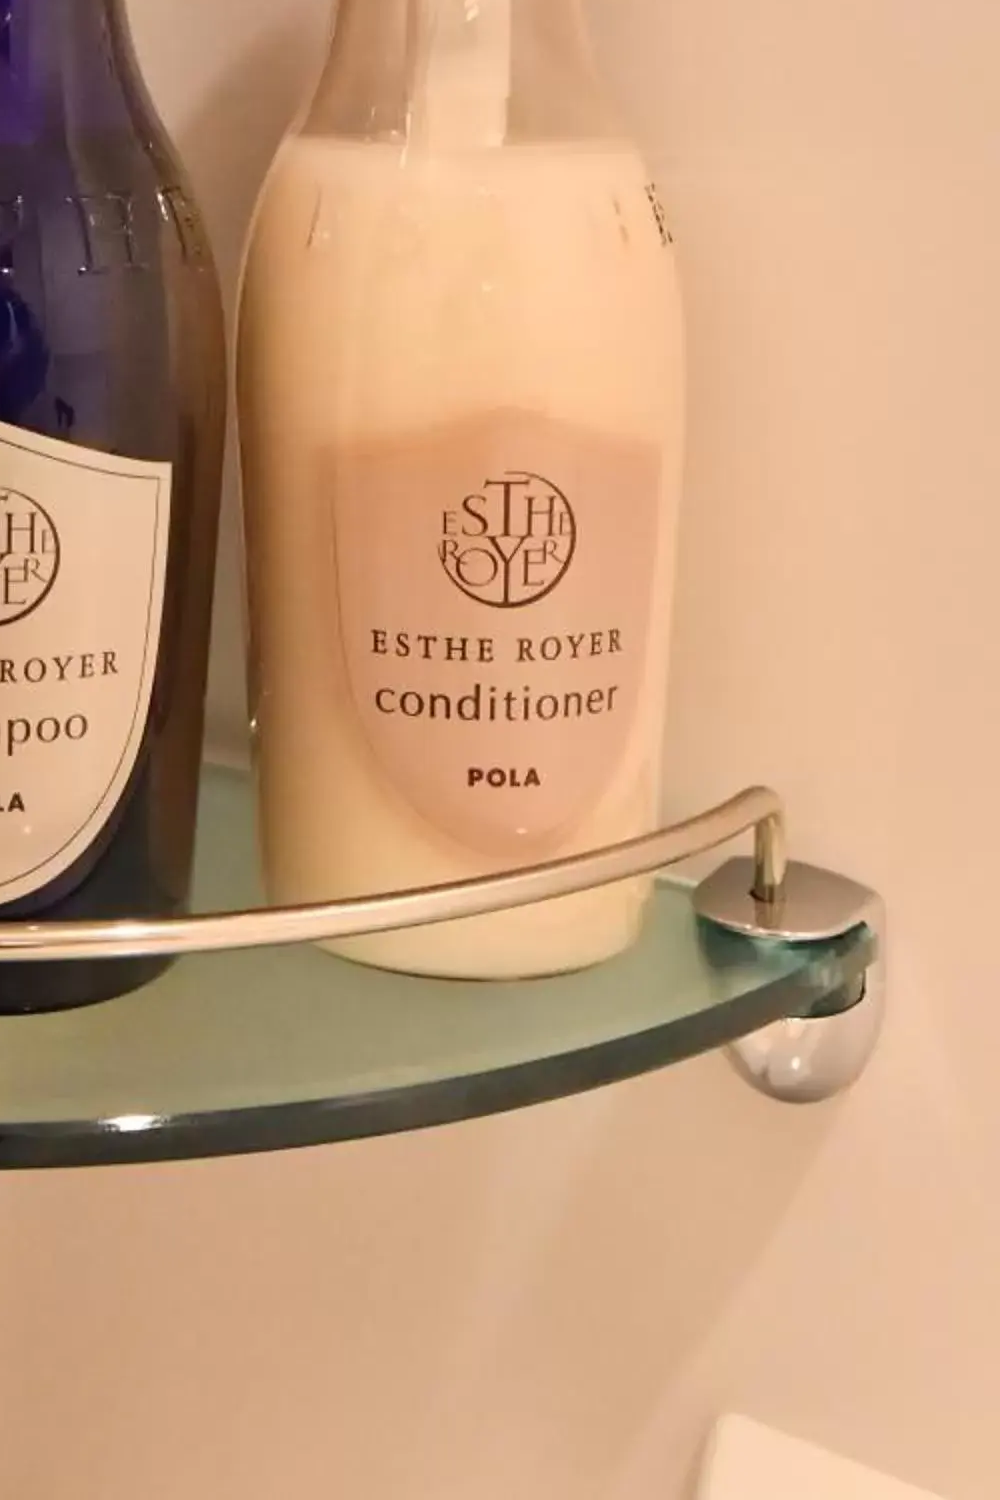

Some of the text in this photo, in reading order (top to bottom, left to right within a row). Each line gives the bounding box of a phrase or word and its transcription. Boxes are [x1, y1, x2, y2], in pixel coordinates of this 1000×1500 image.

[442, 479, 573, 538] ESTHE
[439, 536, 566, 606] ROYER
[370, 628, 623, 663] ESTHE ROYER
[375, 684, 619, 722] conditioner
[467, 767, 541, 789] POLA
